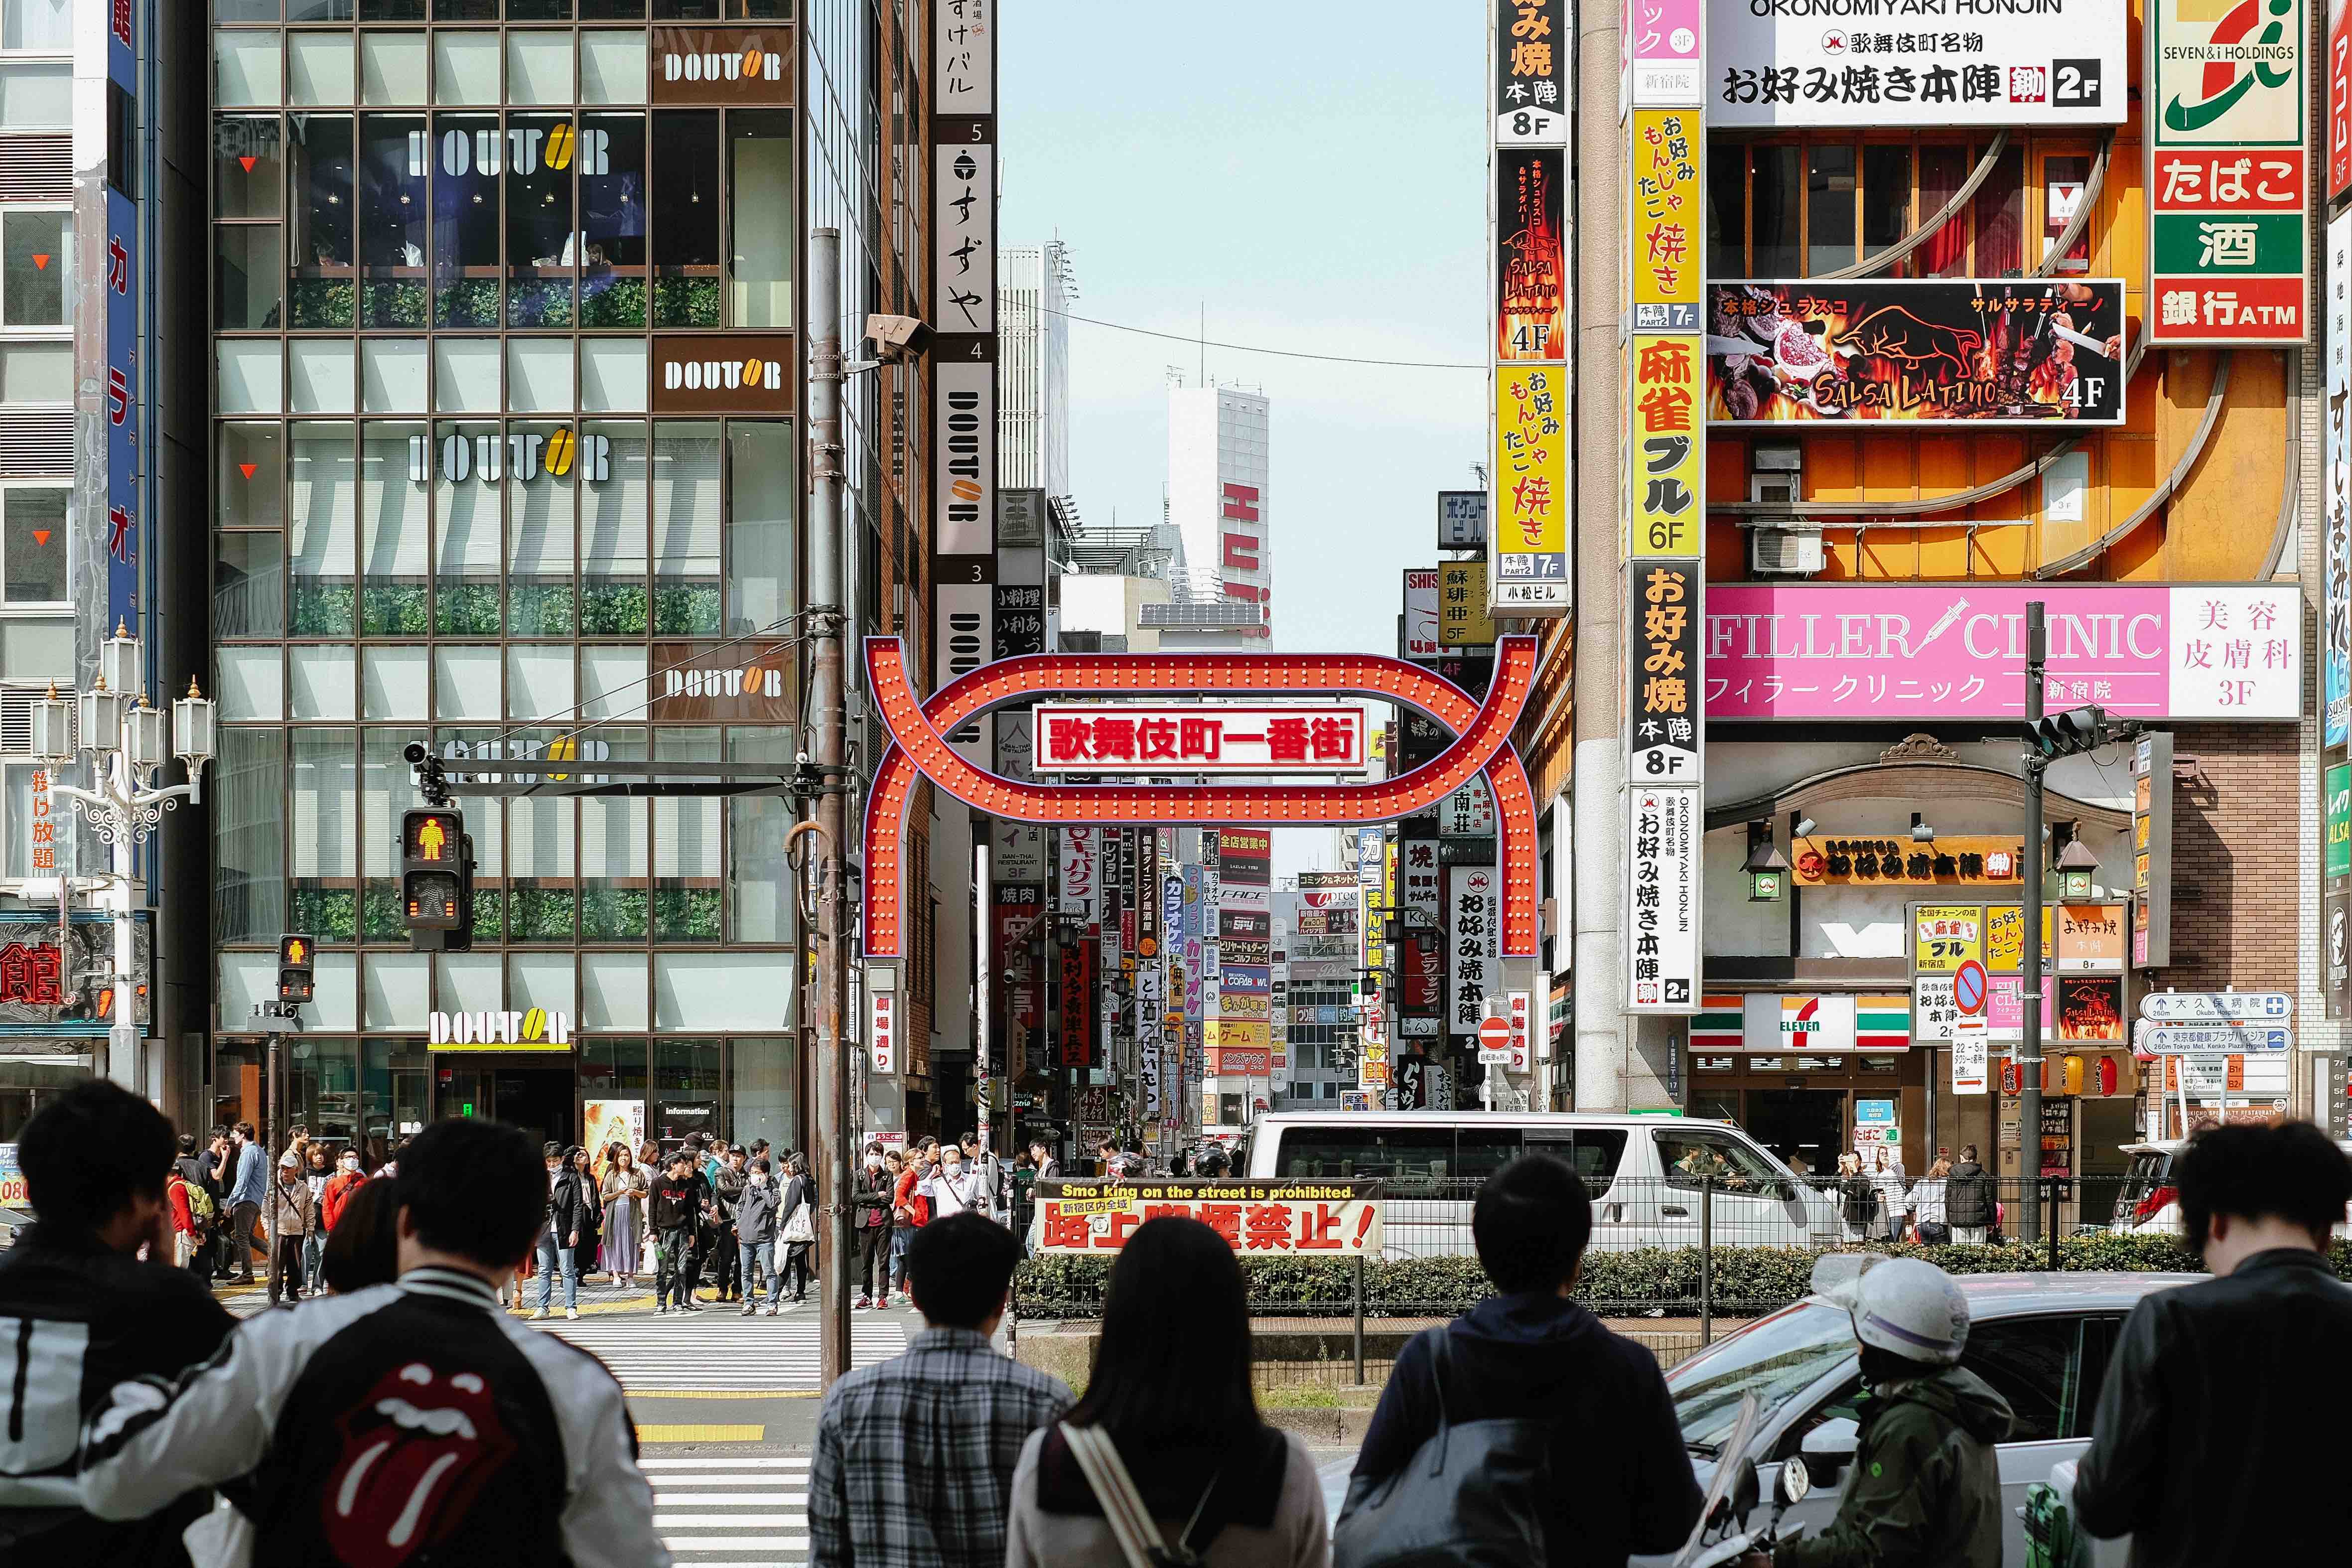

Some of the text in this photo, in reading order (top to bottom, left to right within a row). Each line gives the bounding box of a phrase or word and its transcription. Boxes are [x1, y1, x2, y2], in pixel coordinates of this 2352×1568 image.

[972, 0, 982, 19] 酒場
[1750, 0, 2062, 17] OKONOMIYAKI HONJIN
[1673, 34, 1693, 47] 3F
[1850, 32, 1983, 54] 歌舞伎町名物
[2224, 46, 2294, 60] HOLDINGS
[666, 50, 780, 81] DOUTOR
[1506, 80, 1558, 105] 本陣
[1645, 74, 1690, 89] 新宿院
[1722, 64, 2003, 105] お好み焼き本陣
[2057, 66, 2098, 99] 2F
[2335, 34, 2348, 154] アコム
[971, 124, 982, 142] 5
[1513, 111, 1551, 136] 8F
[408, 124, 609, 176] DOUTOR
[1662, 116, 1696, 182] お好み
[1644, 126, 1684, 213] もんじゃ
[2162, 158, 2295, 203] たばこ
[2335, 156, 2348, 185] 3F
[1532, 159, 1542, 226] 本格シュラスコ
[1638, 175, 1665, 219] たこ
[948, 185, 983, 328] すずや
[2198, 221, 2259, 268] 酒
[1510, 259, 1553, 277] SALSA
[1646, 222, 1687, 295] 焼き
[1640, 305, 1665, 318] 本陣
[1672, 304, 1695, 327] 7F
[1723, 298, 1849, 316] 本格シュラスコ
[1971, 297, 2104, 314] サルサラティーノ
[1640, 318, 1667, 327] PART2
[970, 343, 982, 359] 4
[1512, 324, 1551, 352] 4F
[665, 358, 781, 390] DOUTOR
[1527, 371, 1560, 436] お好み
[1814, 375, 1996, 411] SALSA LATINO
[2061, 377, 2105, 410] 4F
[1510, 381, 1548, 467] もんじゃ
[409, 428, 610, 482] DOUTOR
[948, 391, 982, 523] DOUTOR
[1504, 430, 1532, 472] たこ
[1446, 497, 1487, 520] ポケット
[1511, 475, 1551, 548] 焼き
[1452, 523, 1482, 543] ビル
[1648, 521, 1685, 550] 6F
[971, 565, 982, 582] 3
[1505, 555, 1530, 567] 本陣
[1505, 567, 1531, 575] PART2
[1537, 554, 1559, 577] 7F
[1408, 573, 1438, 589] SHIS
[1508, 586, 1556, 600] 小松ビル
[2199, 600, 2279, 631] 美容
[1446, 627, 1466, 640] 5F
[1644, 568, 1687, 714] お好み焼
[1705, 613, 1915, 659] FILLER
[2184, 639, 2292, 670] 皮膚科
[666, 666, 782, 698] DOUTOR
[2047, 679, 2112, 701] 新宿院
[2218, 680, 2257, 706] 3F
[1049, 717, 1353, 760] 歌舞伎町一番街
[1638, 717, 1692, 743] 本陣
[1646, 749, 1685, 775] 8F
[2328, 789, 2349, 818] レイク
[1664, 797, 1676, 857] 歌舞伎町名物
[1220, 836, 1268, 851] 全店営業中
[1008, 867, 1027, 878] 3F
[1679, 797, 1689, 933] OKONOMIYAKI HONJIN
[1001, 887, 1035, 903] 焼肉
[1142, 835, 1152, 931] 個室ダイニング居酒屋
[1221, 890, 1268, 900] FACE
[1636, 812, 1660, 982] お好み焼き本陣
[1167, 880, 1182, 941] カラオケ
[1207, 908, 1215, 935] SEGA
[1919, 909, 1977, 918] 全国チェーンの店
[1935, 920, 1962, 935] 麻雀
[2063, 918, 2117, 936] お好み焼
[1220, 940, 1268, 953] ビリヤード&ダーツ
[1458, 893, 1484, 1025] お好み焼本陣
[1931, 942, 1965, 958] ブル
[1207, 948, 1215, 975] SEGA
[1918, 959, 1946, 969] 新宿店
[2082, 960, 2095, 969] 8F
[1186, 938, 1201, 1015] カラオケ
[1666, 982, 1689, 1000] 2F
[2176, 997, 2261, 1009] 大久保病院
[429, 1007, 569, 1044] DOUTOR
[876, 998, 889, 1066] 劇場通り
[1221, 1029, 1251, 1042] ゲーム
[1512, 998, 1526, 1067] 劇場通り
[2173, 1031, 2266, 1043] 東京都健康プラザハイジア
[1222, 1052, 1266, 1064] メンズサウナ
[1854, 1128, 1881, 1140] たばこ
[1886, 1129, 1898, 1140] 酒
[1142, 1189, 1163, 1198] on
[1167, 1185, 1192, 1198] the
[1197, 1186, 1246, 1199] street
[1250, 1186, 1265, 1199] is
[1269, 1185, 1356, 1201] prohibited.
[1063, 1199, 1129, 1214] 新宿区内全域
